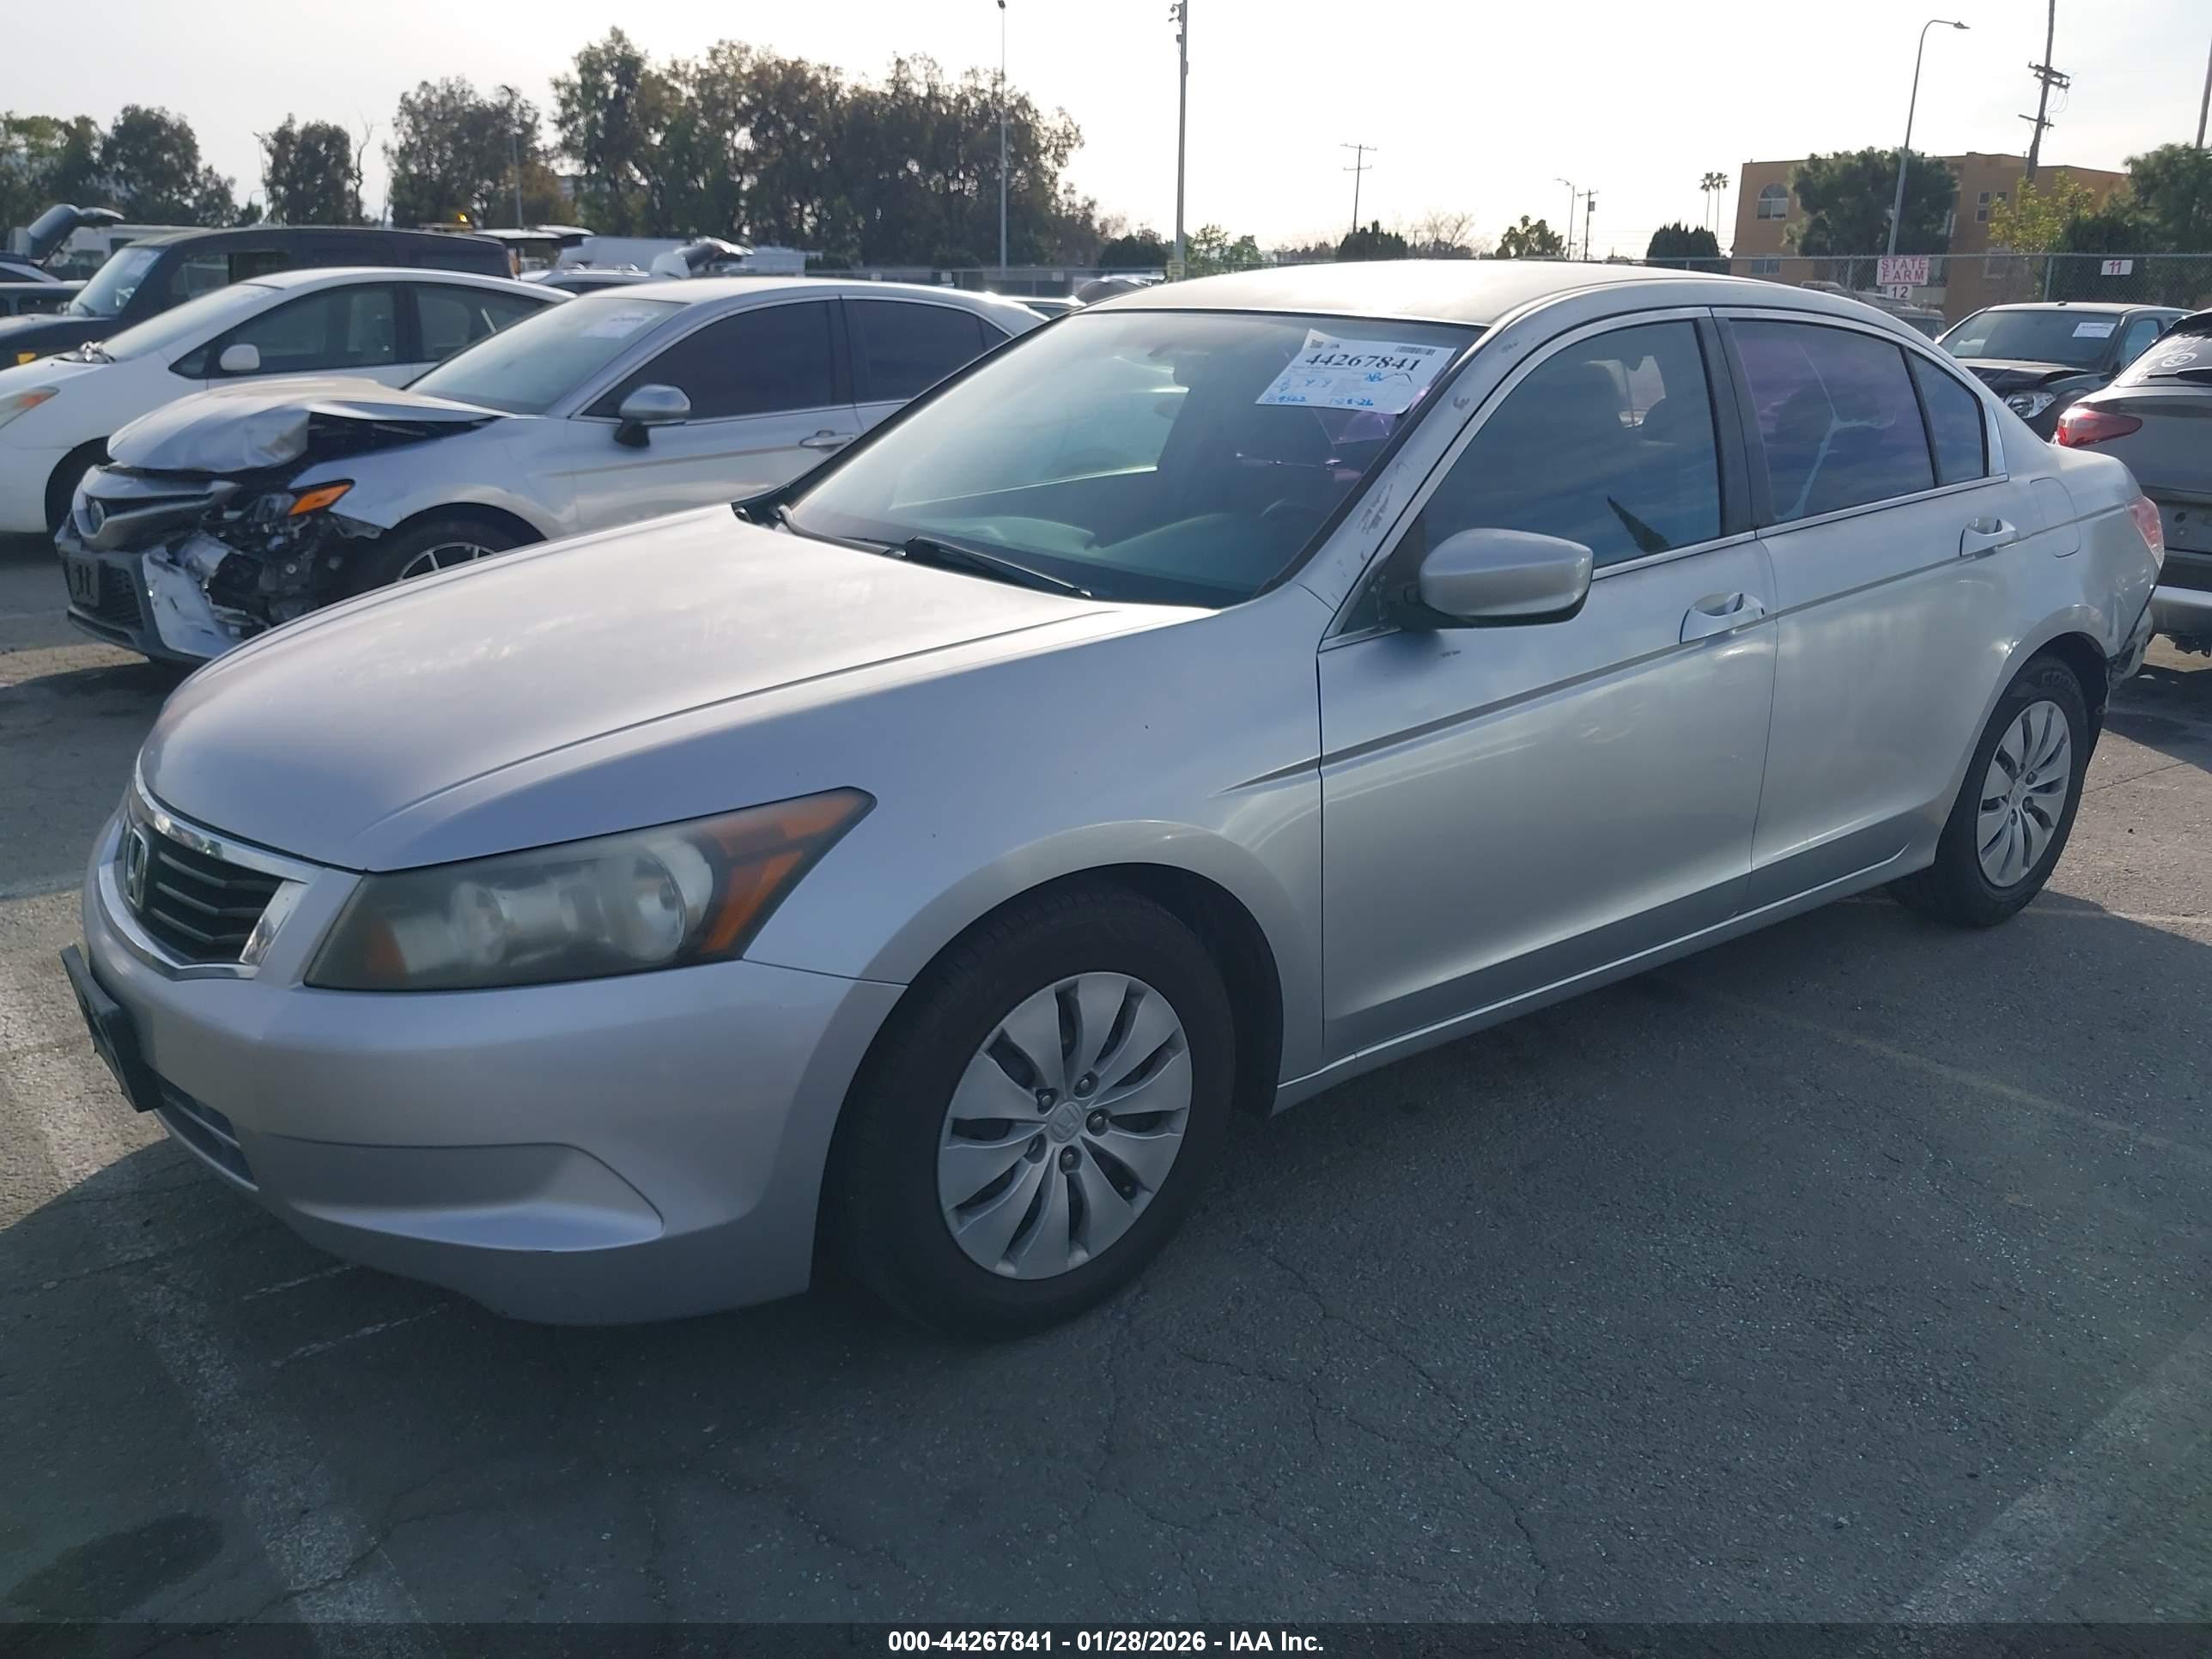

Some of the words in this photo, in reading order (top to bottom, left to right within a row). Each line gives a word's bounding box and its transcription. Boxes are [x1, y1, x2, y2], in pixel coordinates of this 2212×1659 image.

[1881, 258, 1926, 270] STATE
[2108, 260, 2122, 274] 11
[1881, 270, 1924, 282] FARM
[1891, 286, 1909, 299] 12
[1304, 353, 1422, 372] 44267841
